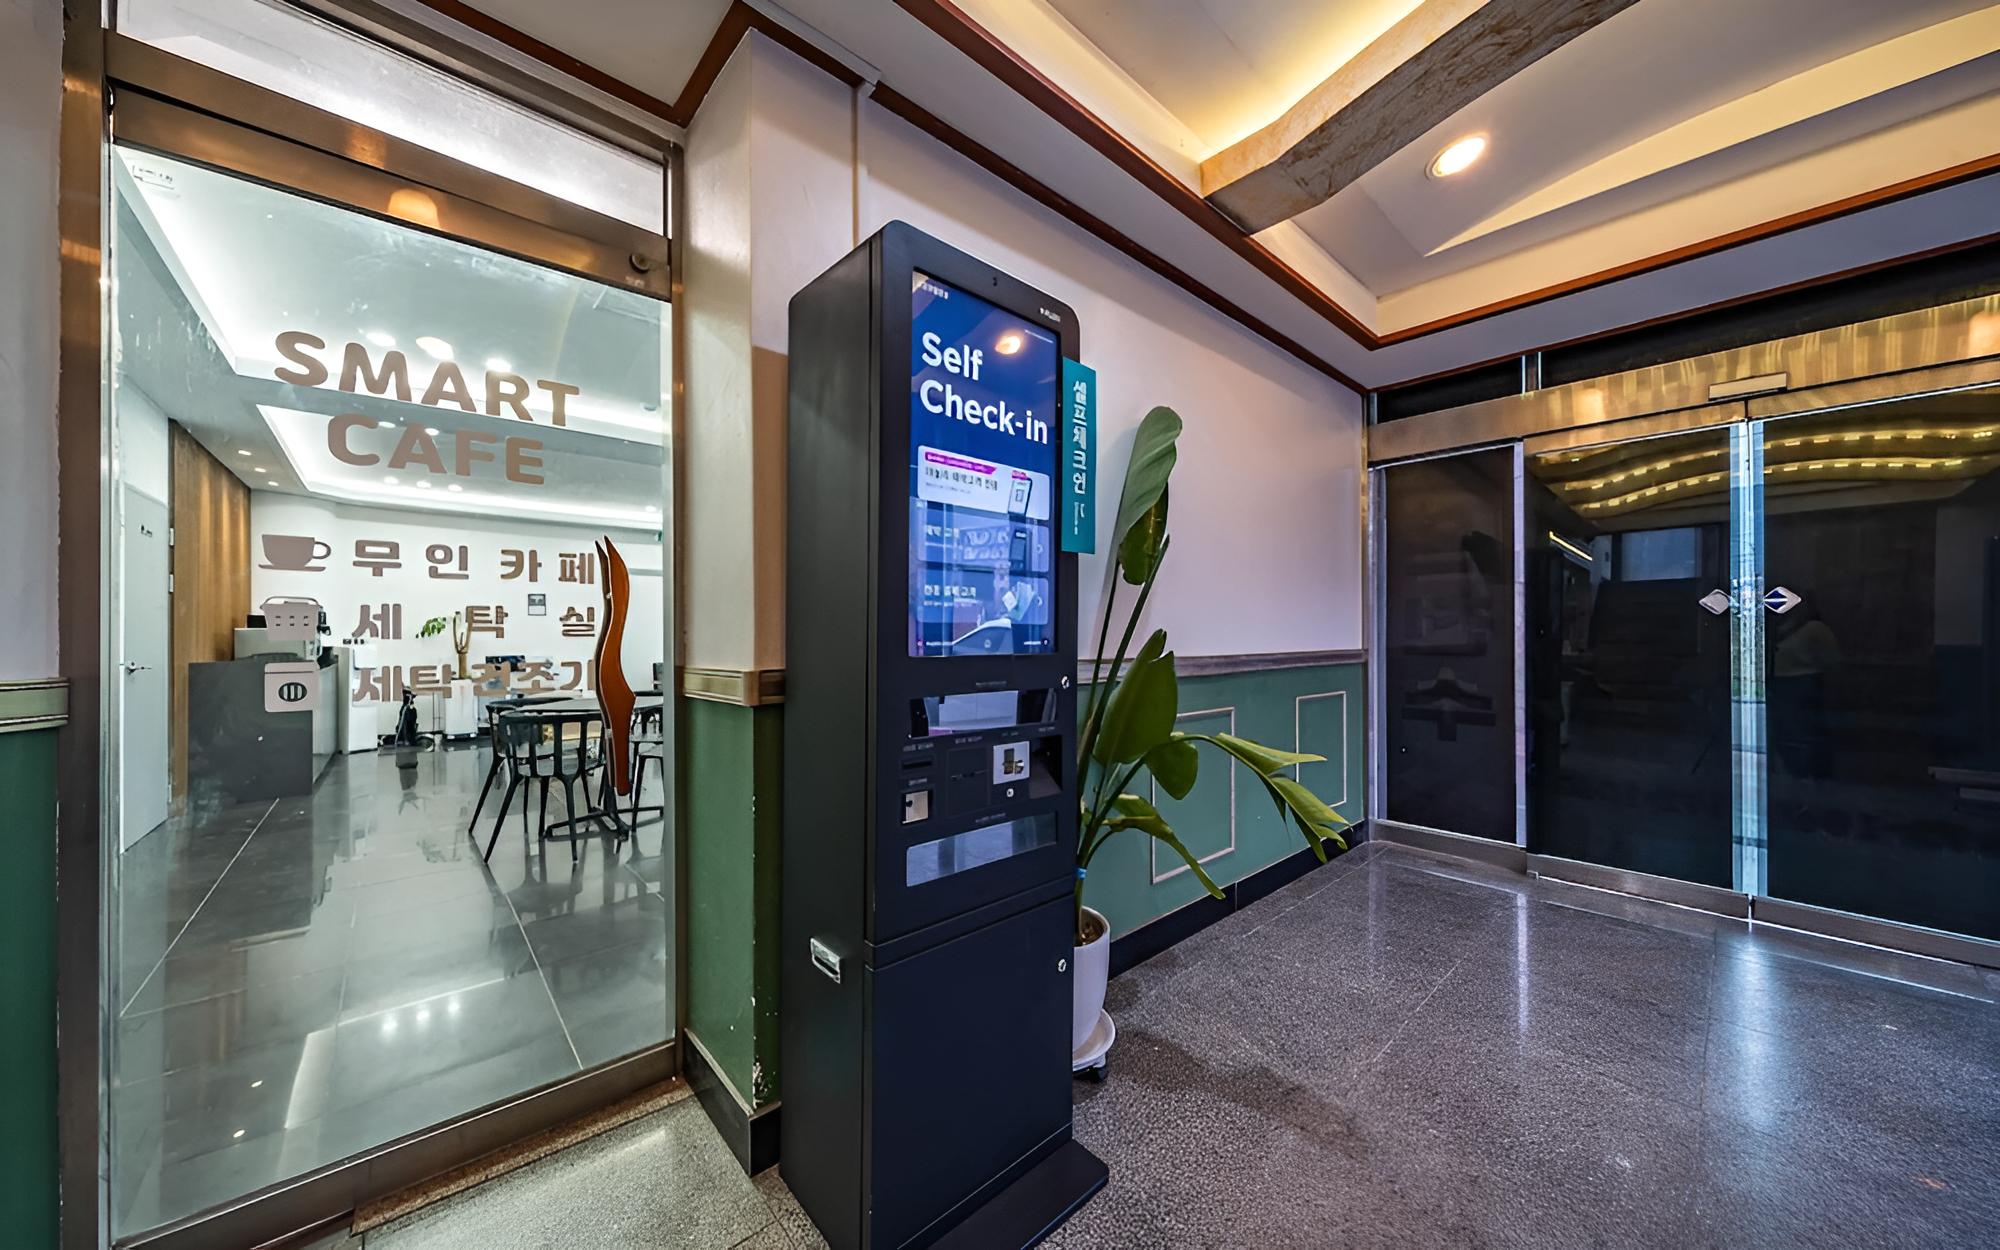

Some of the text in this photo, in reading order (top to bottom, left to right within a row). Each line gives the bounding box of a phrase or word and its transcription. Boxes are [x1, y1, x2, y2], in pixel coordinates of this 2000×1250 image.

[275, 331, 580, 427] SMART
[922, 332, 983, 380] Self
[920, 380, 1047, 444] Check-in
[327, 413, 544, 484] CAFE
